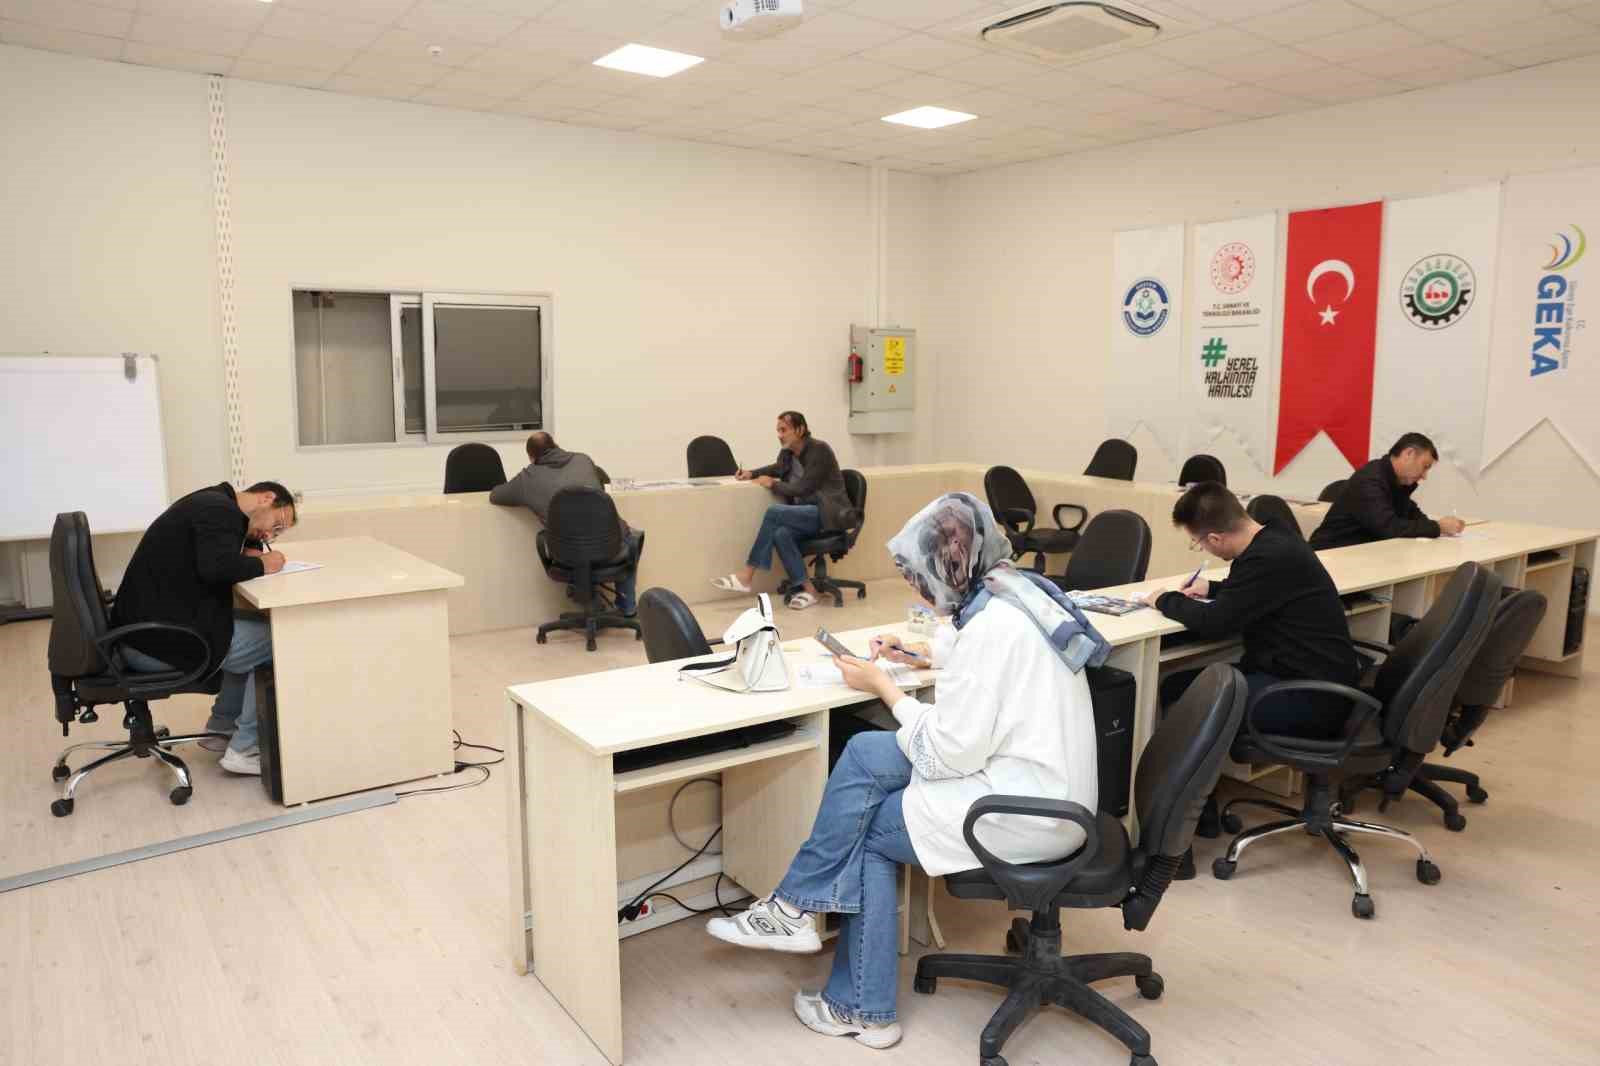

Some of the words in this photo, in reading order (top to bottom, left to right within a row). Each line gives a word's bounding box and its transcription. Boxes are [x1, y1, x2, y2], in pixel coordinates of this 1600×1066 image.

[1530, 274, 1567, 377] GEKA
[1226, 357, 1259, 371] YEREL
[1204, 371, 1257, 384] KALKINMA
[1208, 384, 1254, 398] HAMLESİ
